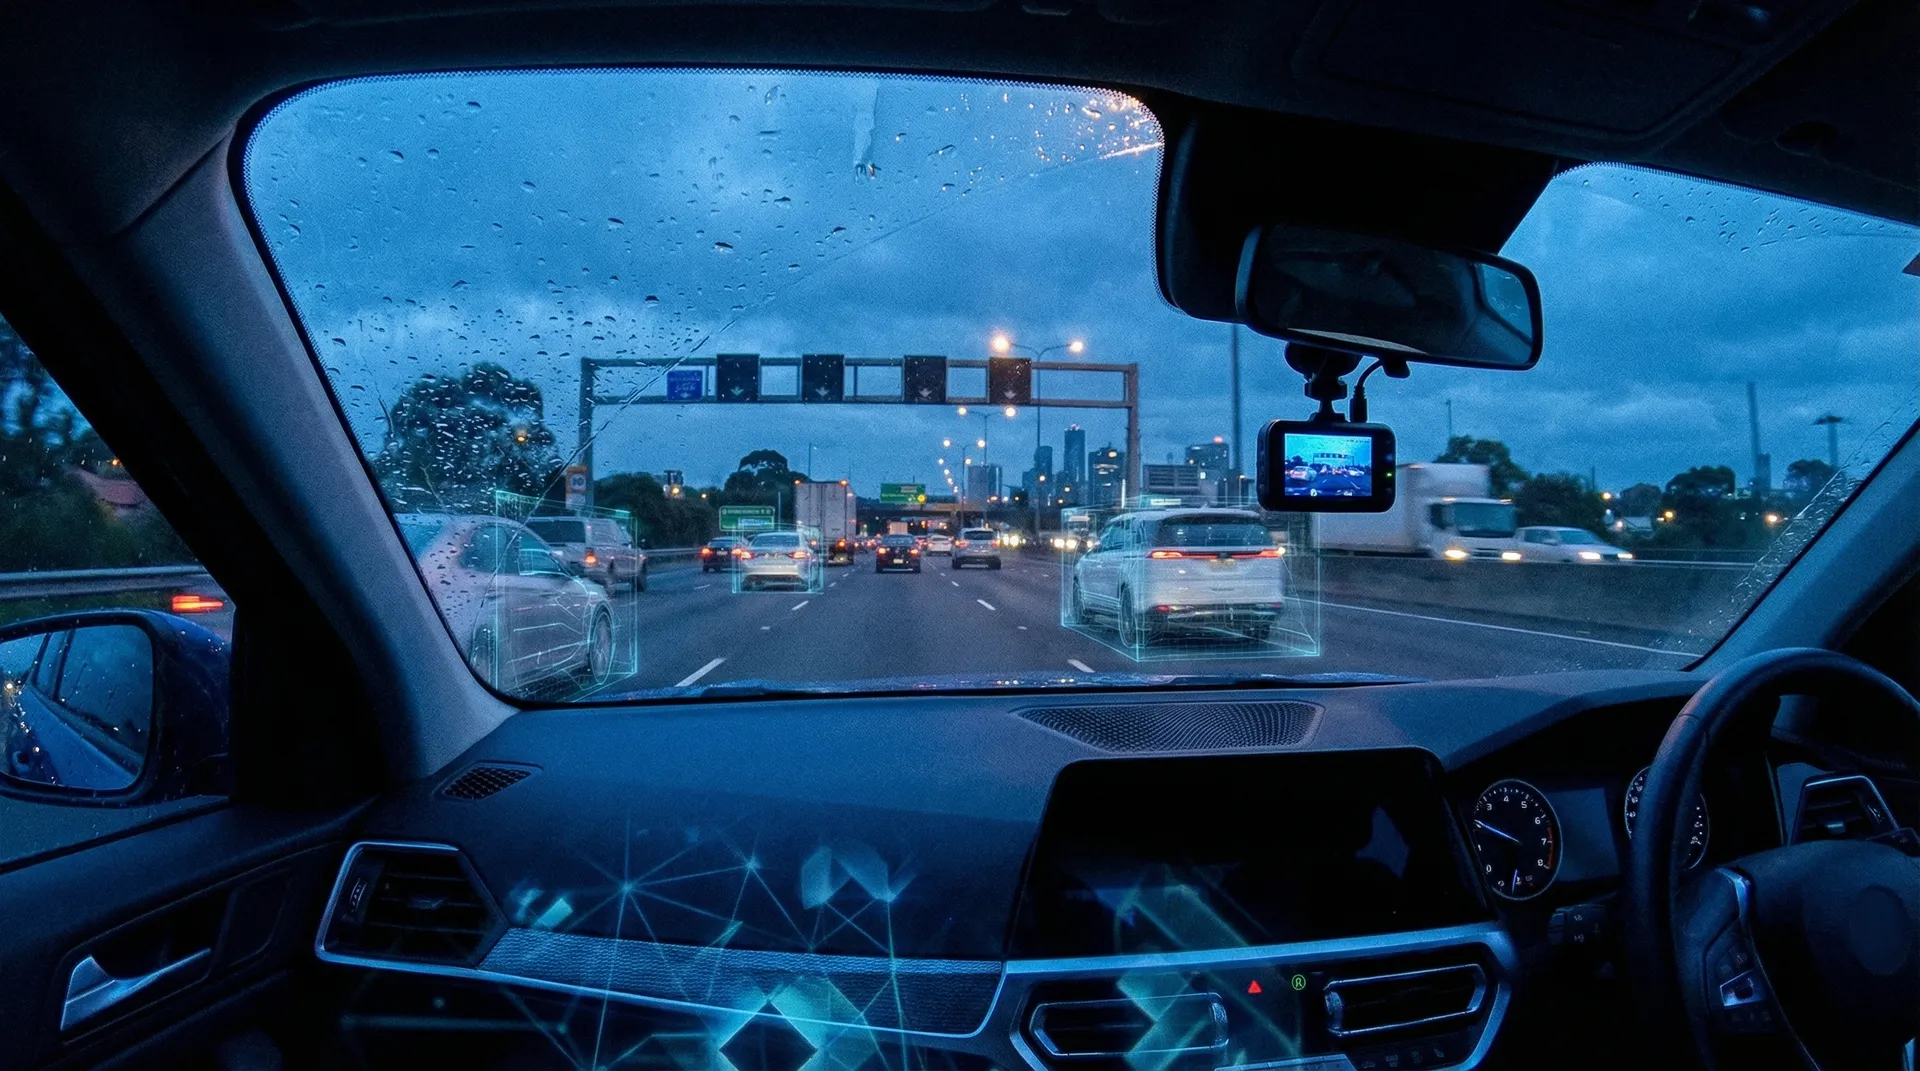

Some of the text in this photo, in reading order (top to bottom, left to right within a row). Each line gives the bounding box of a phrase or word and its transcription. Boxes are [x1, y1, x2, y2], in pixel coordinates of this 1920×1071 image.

[1521, 801, 1527, 809] 5
[1534, 816, 1541, 825] 6
[1486, 864, 1492, 872] 0
